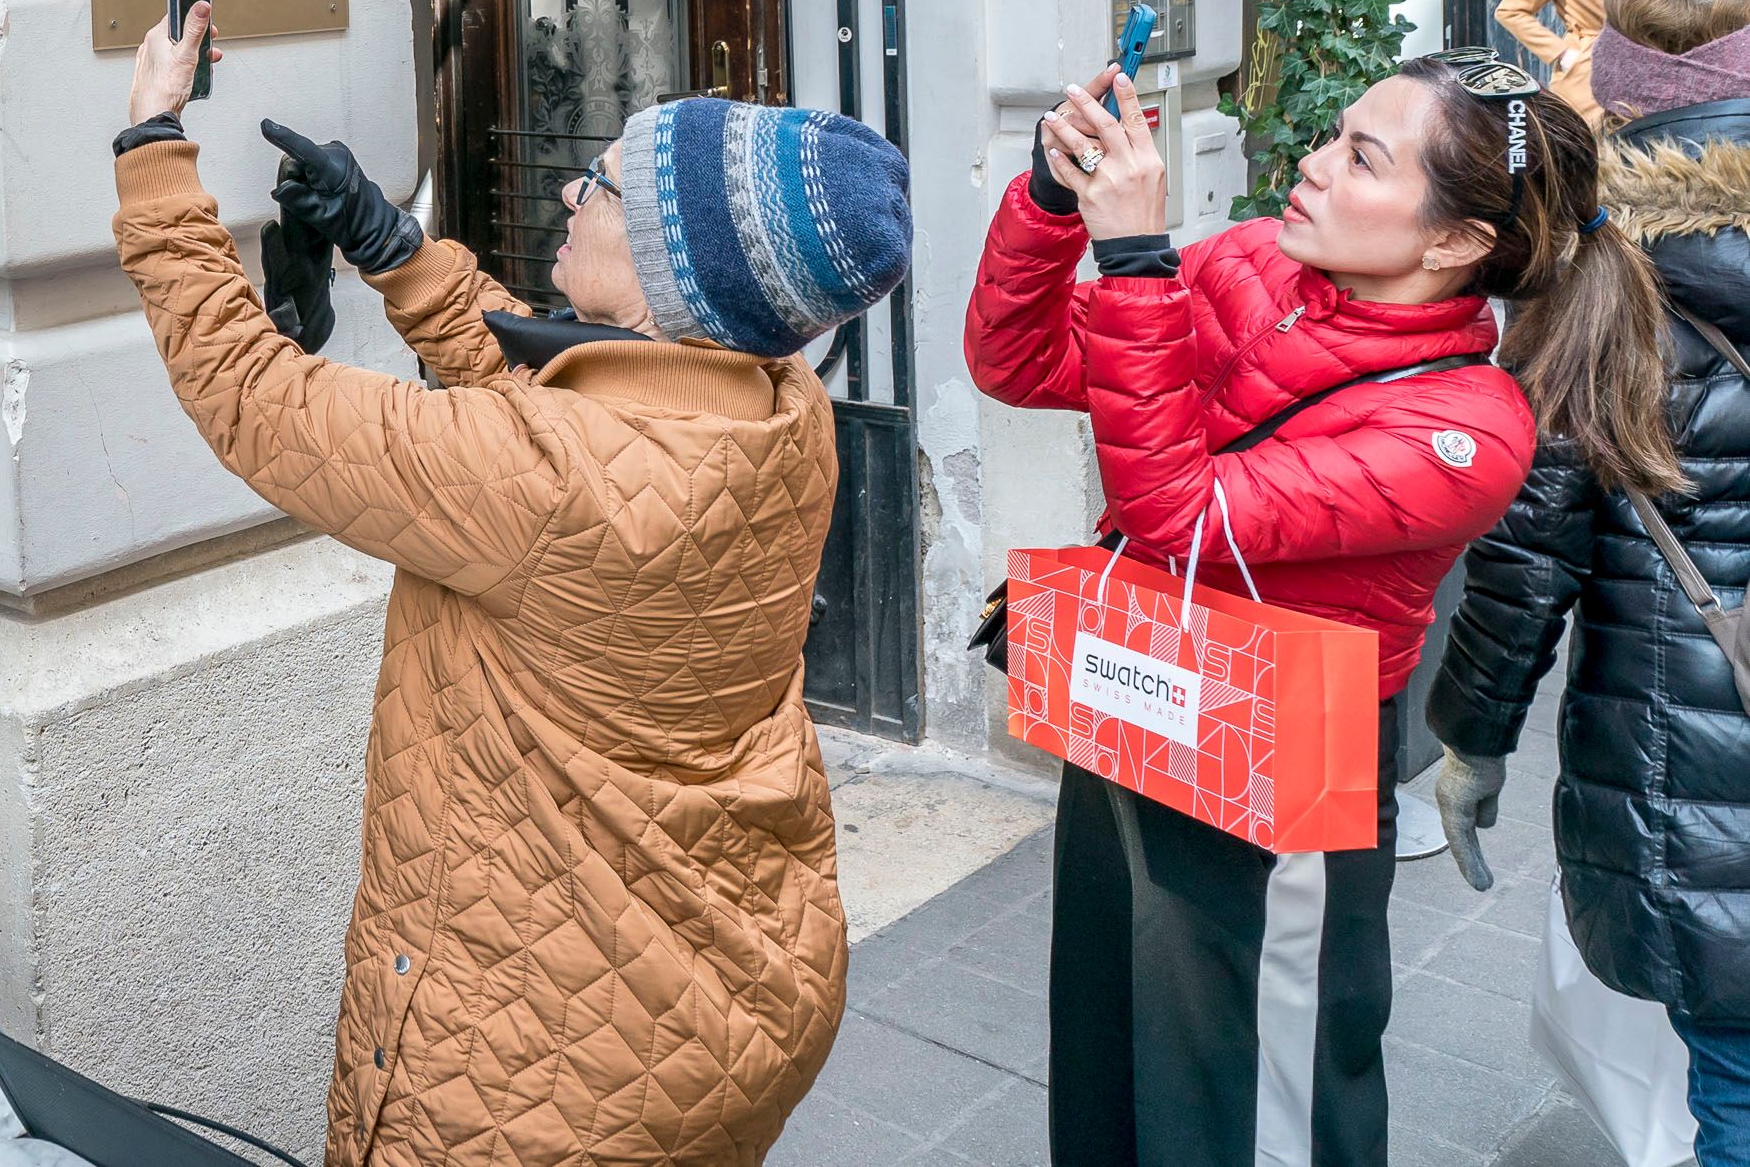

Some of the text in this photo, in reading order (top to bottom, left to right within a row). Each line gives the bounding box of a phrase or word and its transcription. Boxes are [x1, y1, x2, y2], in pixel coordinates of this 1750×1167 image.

[1507, 99, 1527, 175] CHANEL
[1083, 678, 1186, 726] SWISS MADE
[1084, 653, 1170, 702] swatch
